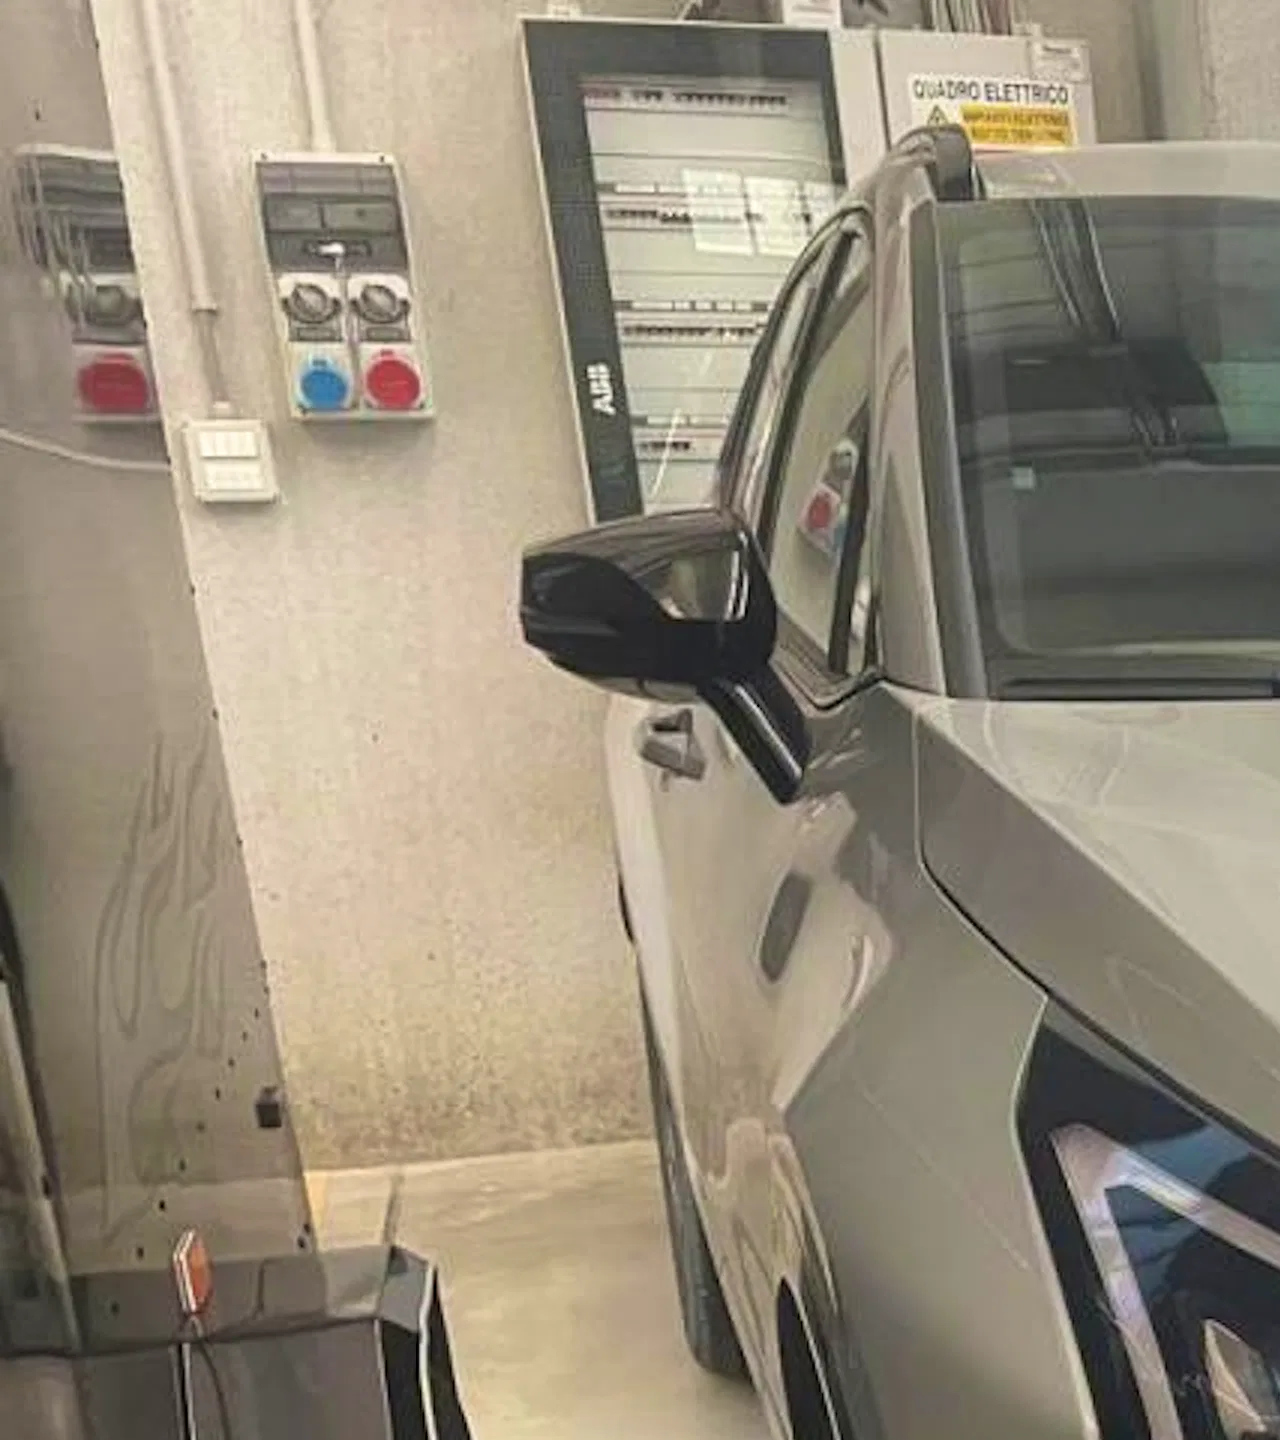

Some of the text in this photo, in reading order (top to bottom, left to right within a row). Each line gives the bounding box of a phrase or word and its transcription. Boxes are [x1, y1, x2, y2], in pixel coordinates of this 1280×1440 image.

[913, 79, 1068, 104] QUADRO ELETTRICO
[587, 363, 616, 415] ABB
